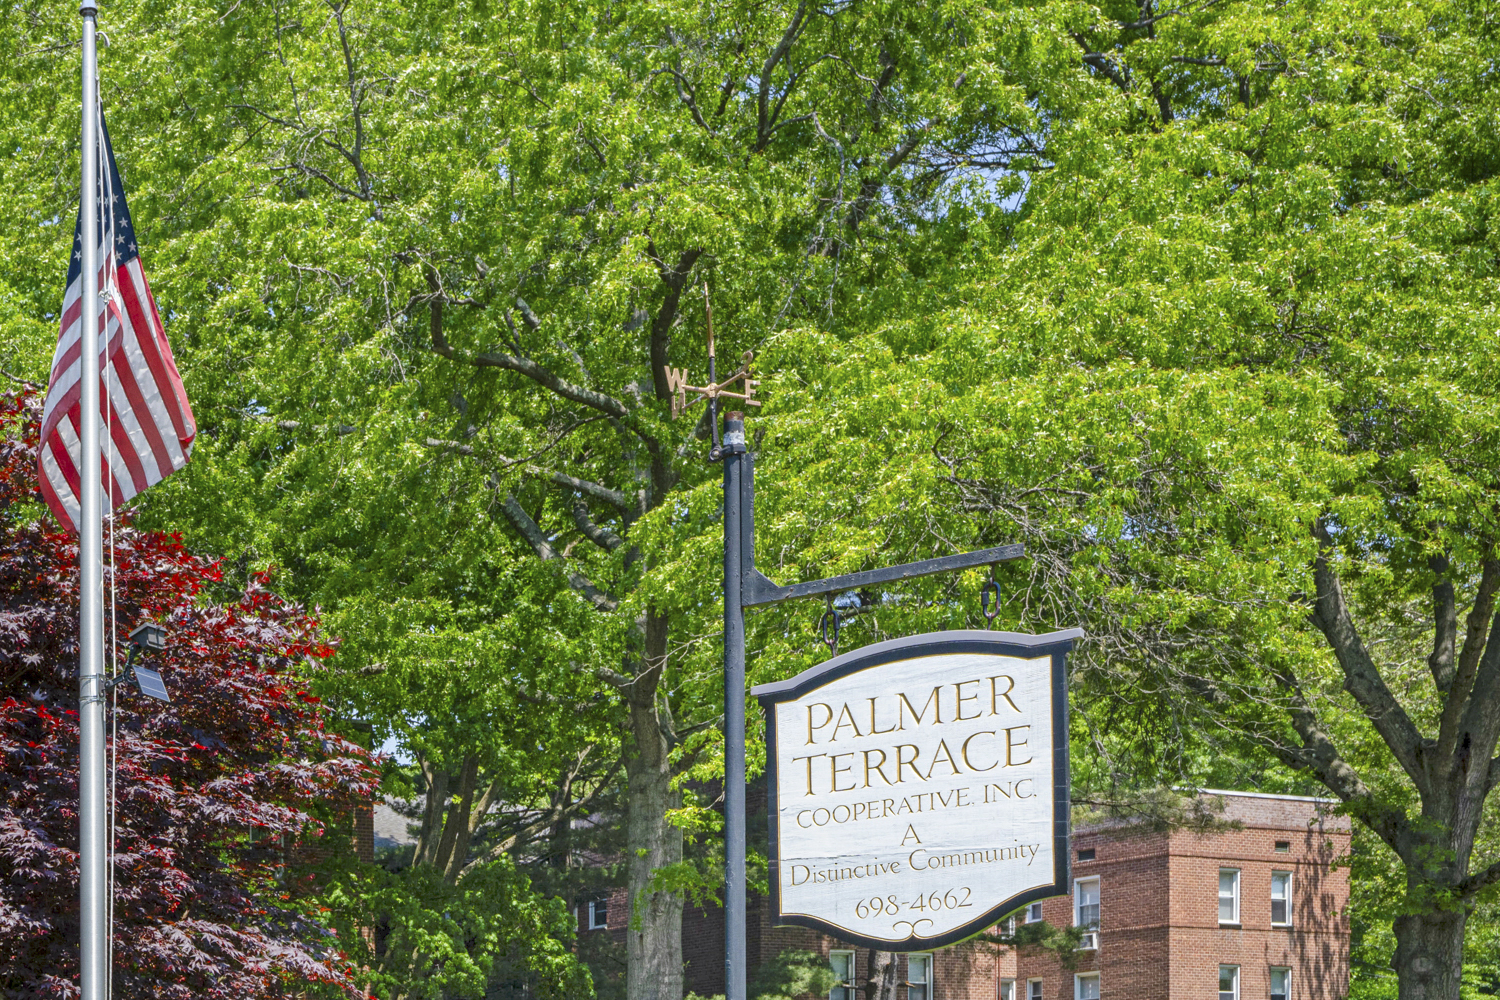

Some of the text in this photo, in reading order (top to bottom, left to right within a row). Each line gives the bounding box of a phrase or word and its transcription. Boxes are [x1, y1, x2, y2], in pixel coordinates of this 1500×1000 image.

[664, 365, 688, 393] W
[745, 379, 761, 406] E
[804, 674, 1022, 746] PALMER
[792, 724, 1033, 797] TERRACE
[983, 778, 1037, 804] INC.
[900, 823, 922, 847] A
[790, 839, 1040, 887] Distinctive Community
[855, 886, 973, 920] 698-4662
